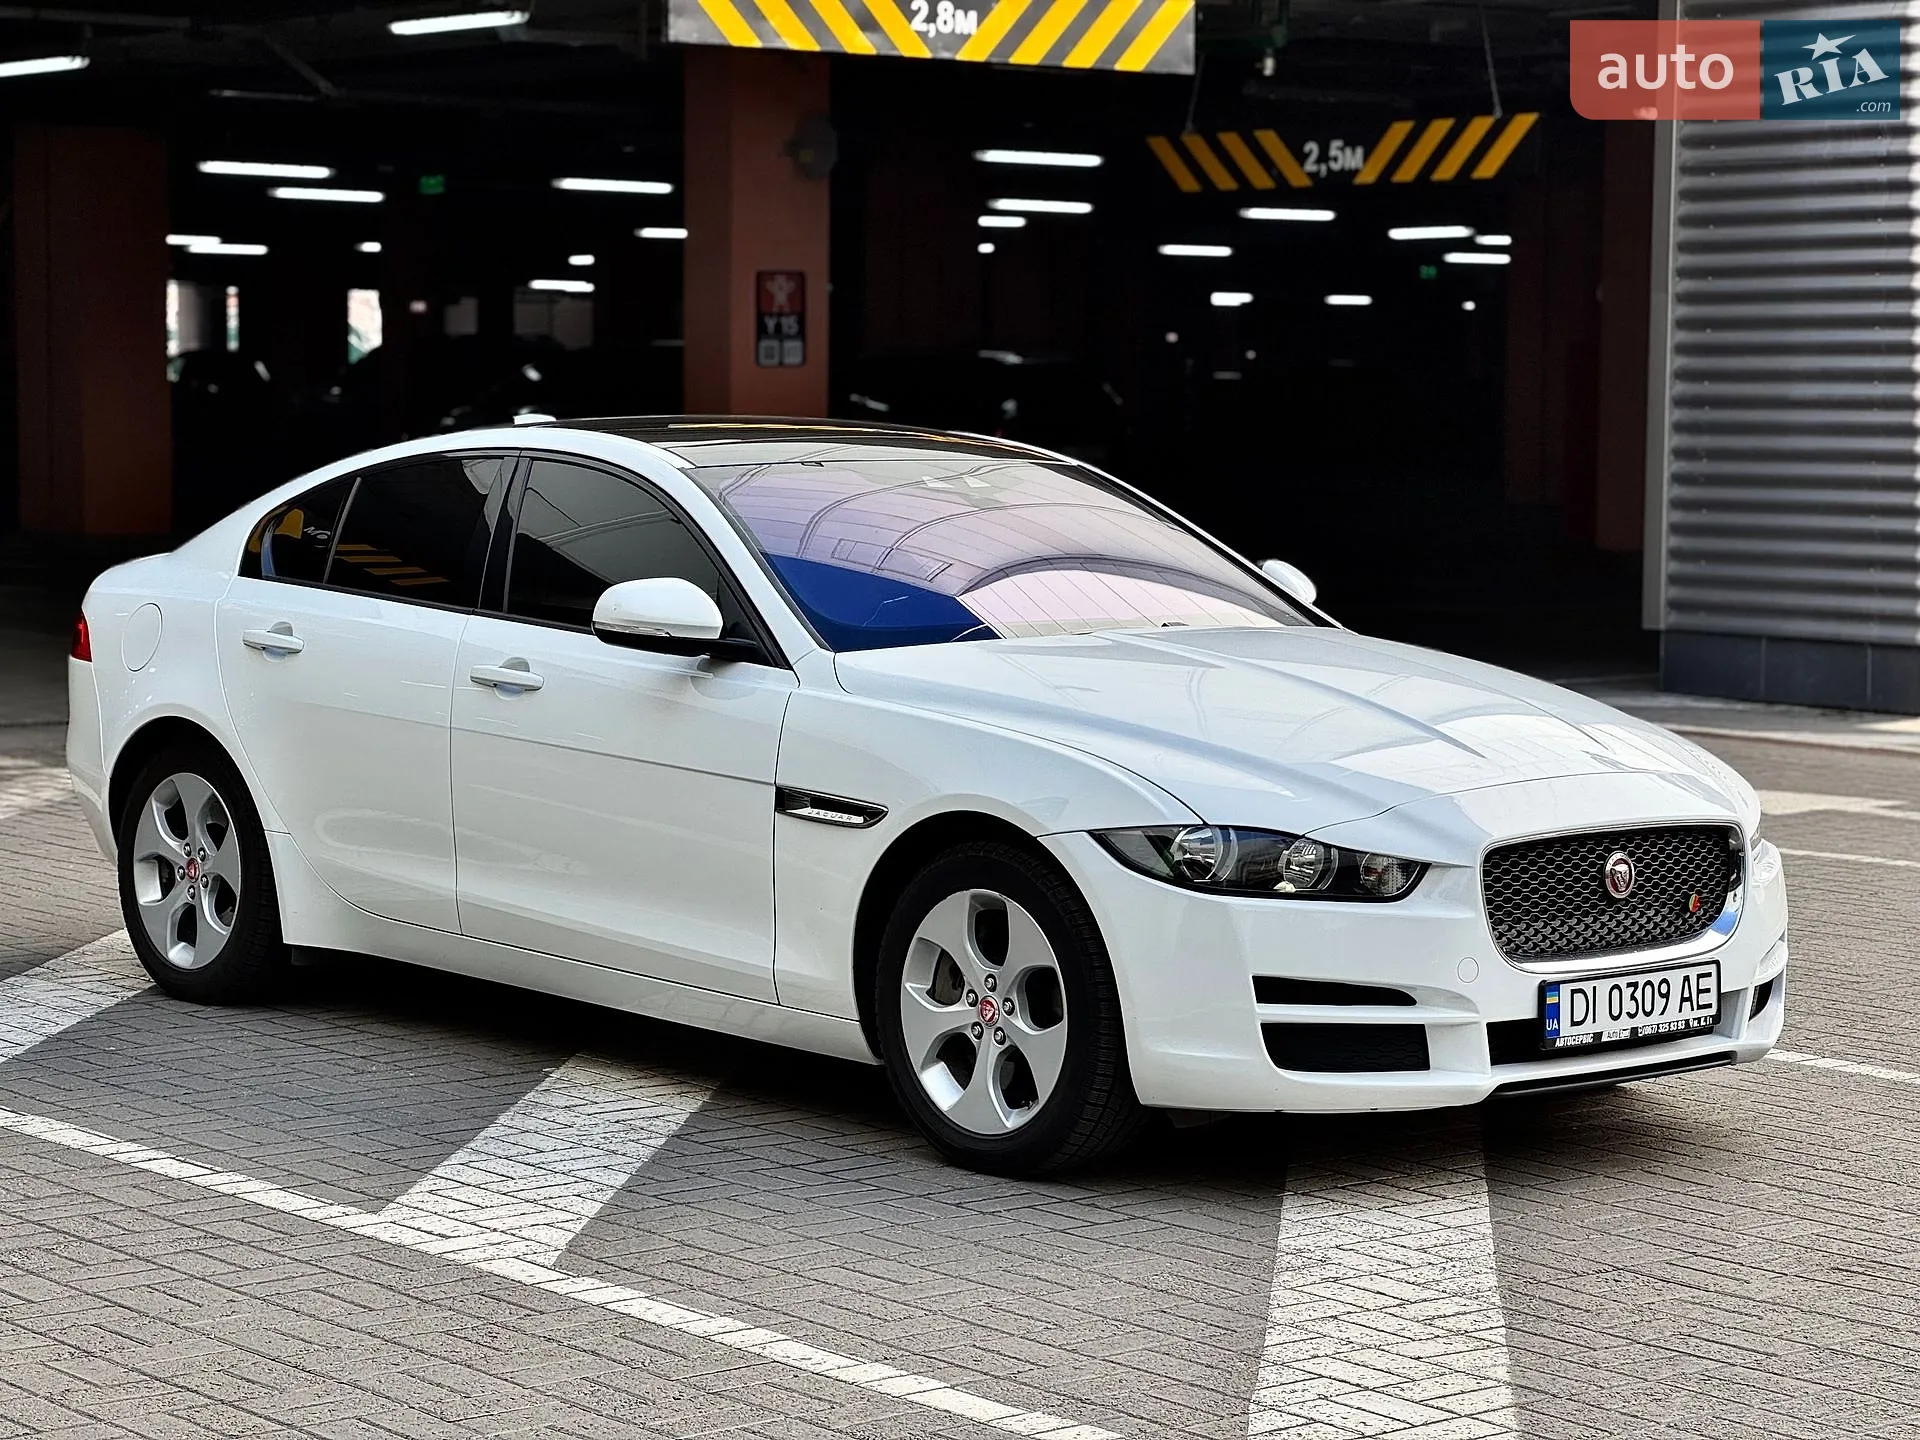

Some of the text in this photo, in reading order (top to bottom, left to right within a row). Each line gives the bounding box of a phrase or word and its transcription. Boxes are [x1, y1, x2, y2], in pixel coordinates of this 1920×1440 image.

[1570, 971, 1713, 1027] DI 0309 AE
[1546, 1018, 1559, 1031] UA
